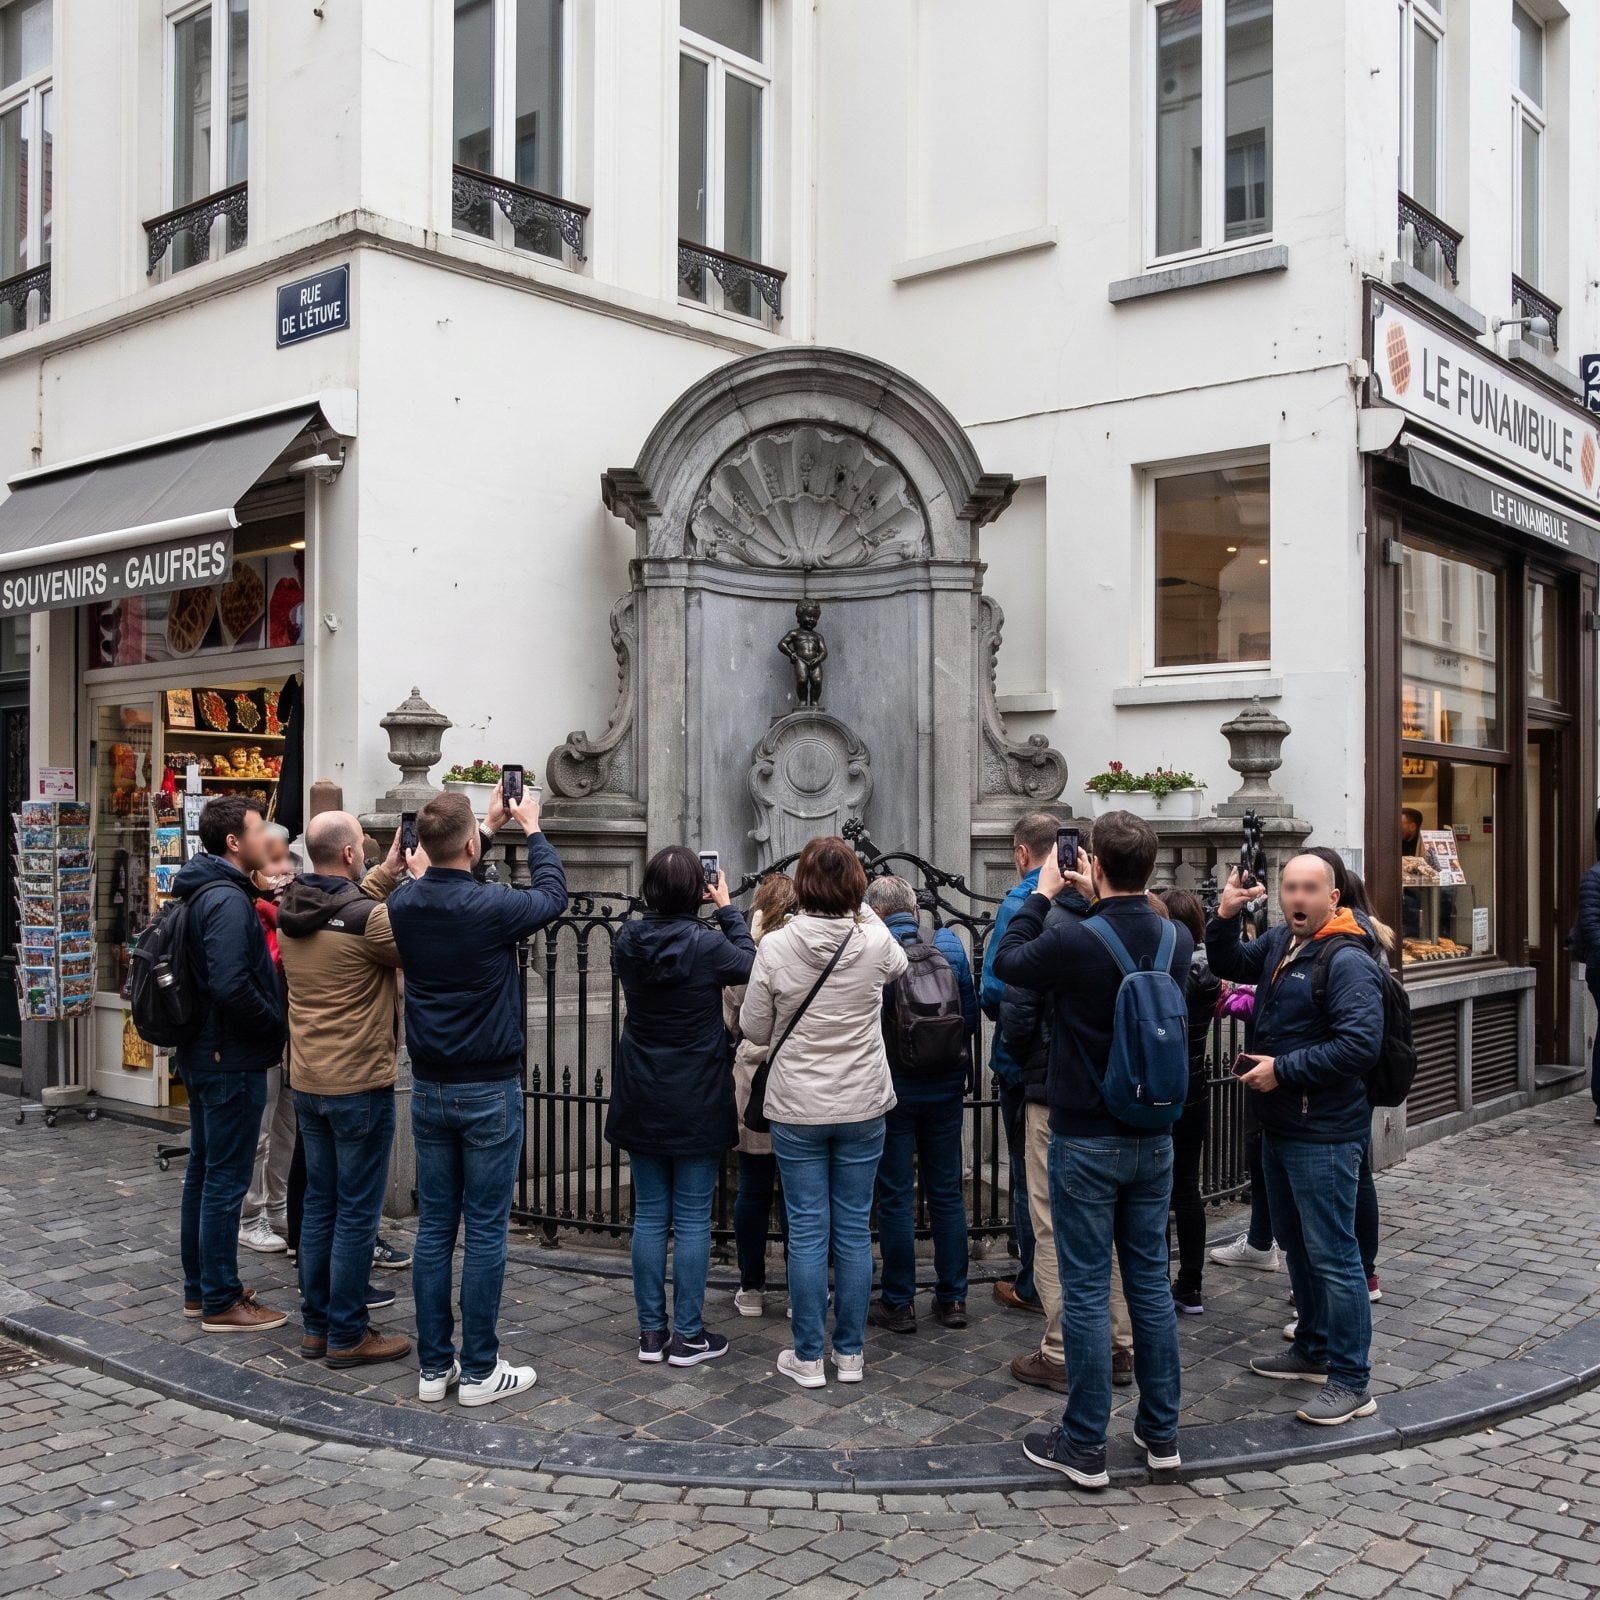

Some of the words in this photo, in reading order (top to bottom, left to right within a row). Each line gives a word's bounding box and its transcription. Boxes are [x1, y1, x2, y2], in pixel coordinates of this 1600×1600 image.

[282, 315, 296, 335] DE
[300, 301, 340, 330] L'ÉTUVE
[301, 283, 321, 306] RUE
[1423, 348, 1450, 409] LE
[1458, 367, 1573, 473] FUNAMBULE
[1491, 490, 1505, 518] LE
[1507, 499, 1569, 545] FUNAMBULE
[2, 563, 107, 610] SOUVENIRS
[125, 541, 226, 589] GAUFRES
